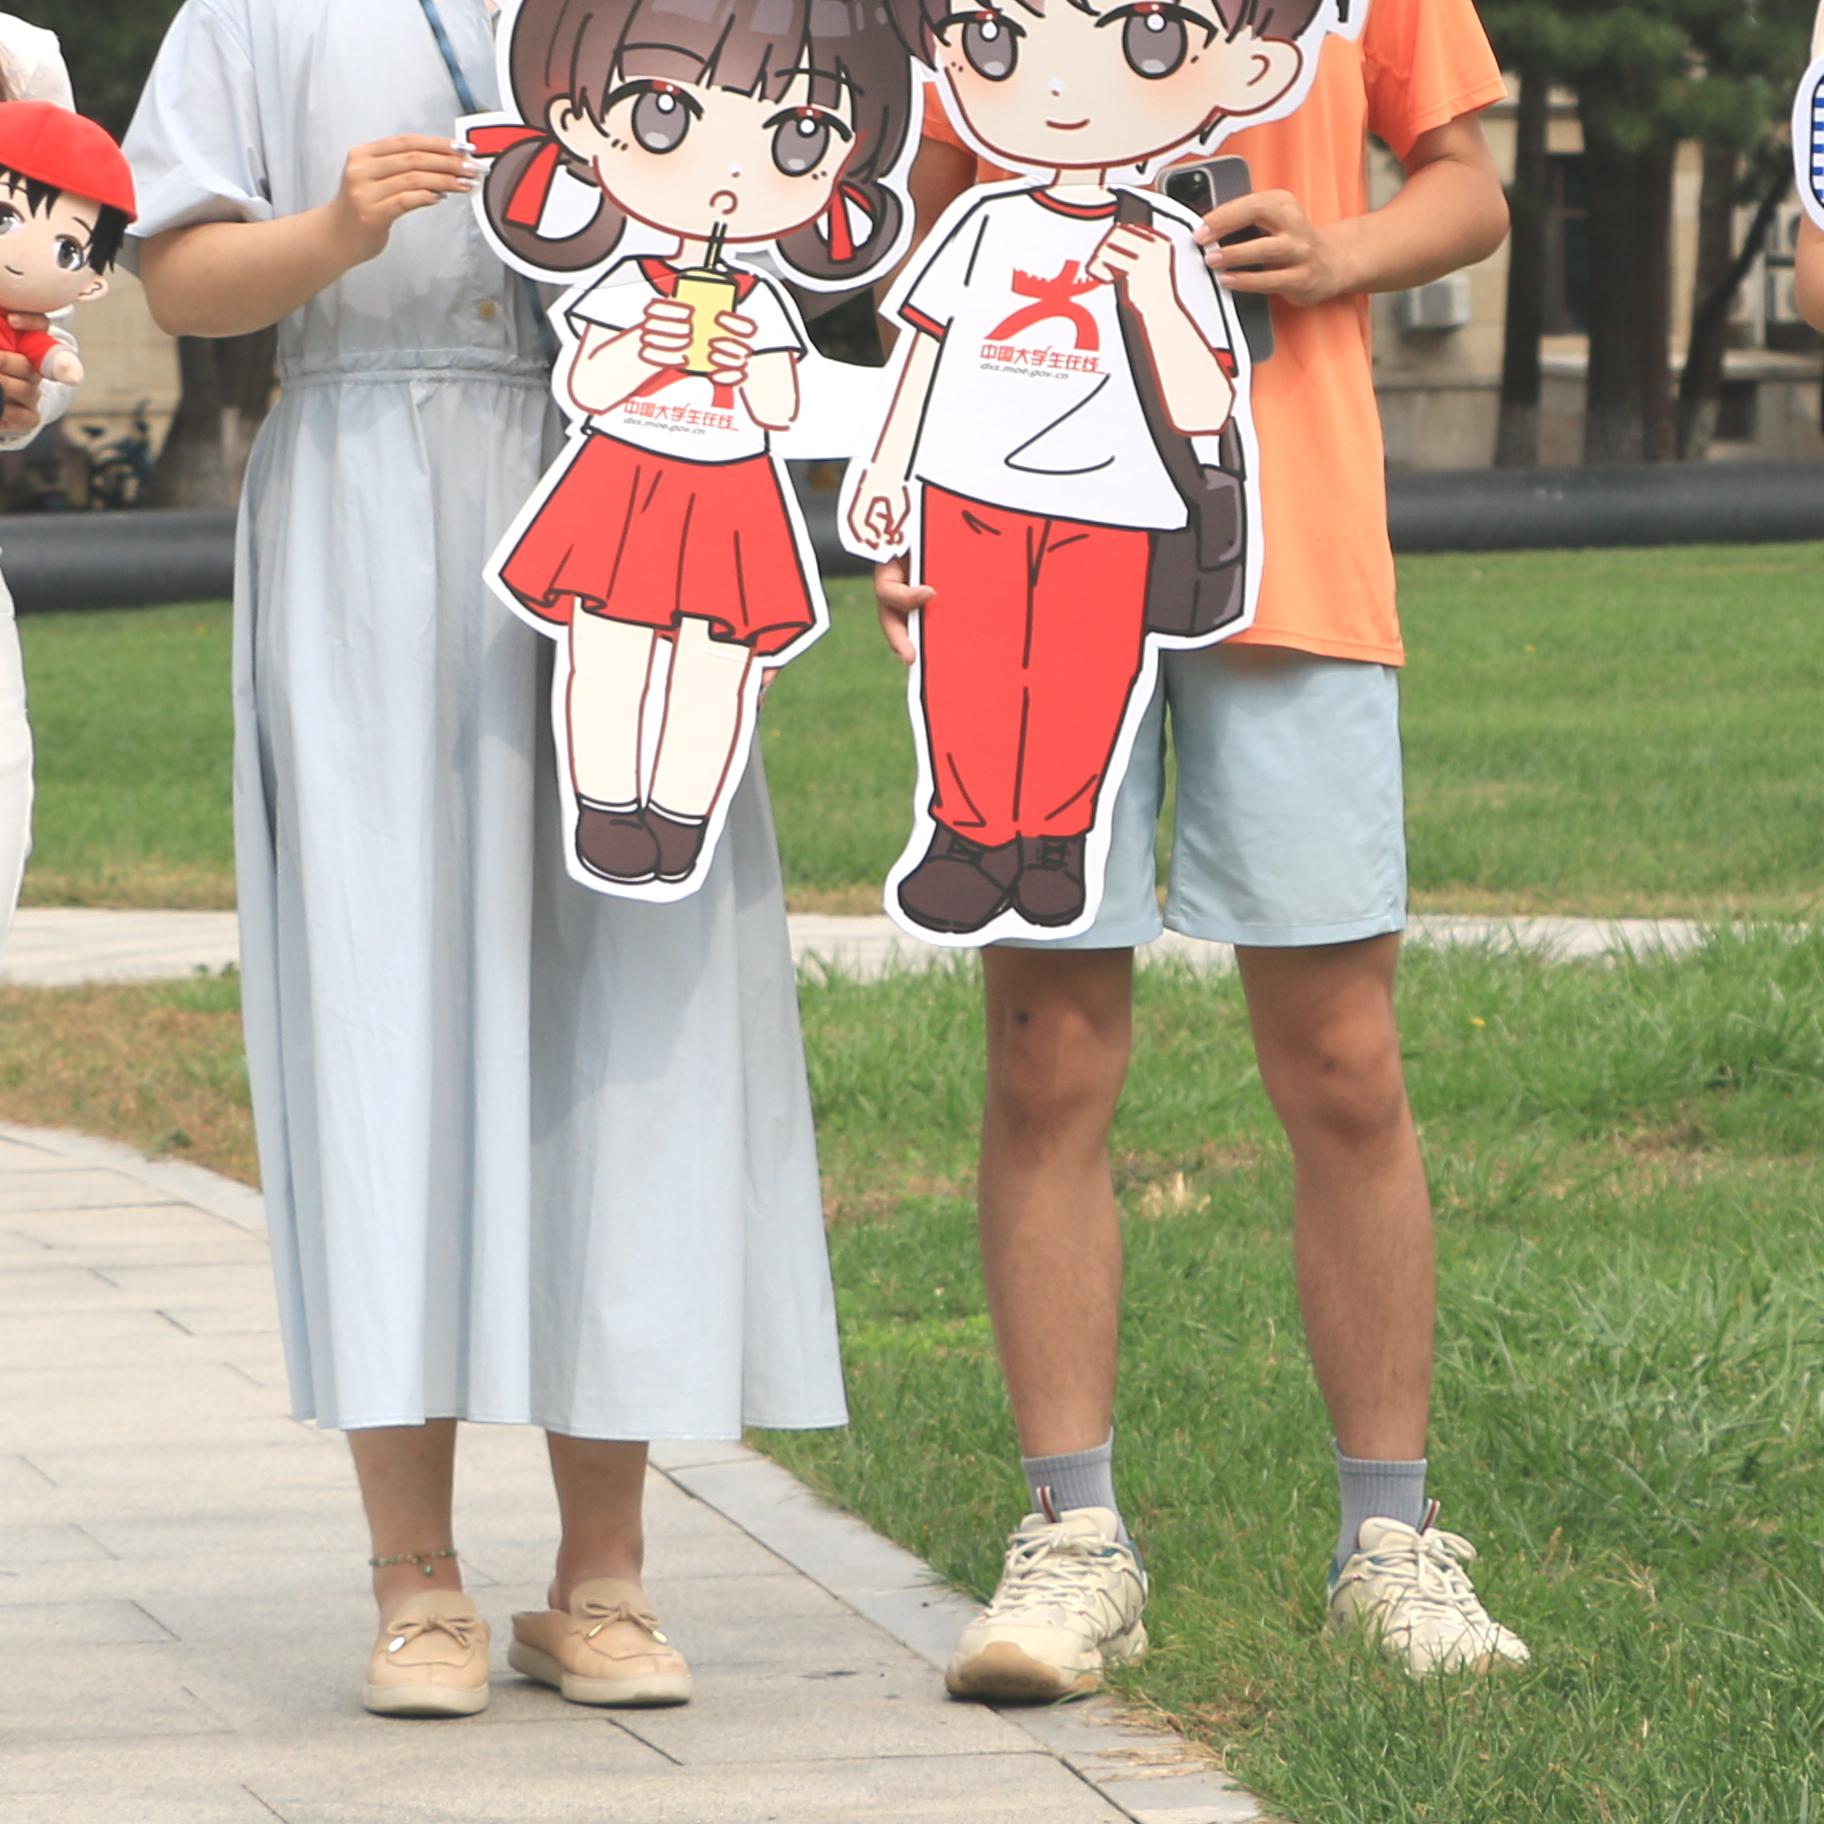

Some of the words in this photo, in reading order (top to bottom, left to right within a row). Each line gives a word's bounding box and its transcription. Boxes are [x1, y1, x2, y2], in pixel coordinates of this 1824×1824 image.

[980, 344, 1106, 375] 中国大学生在线
